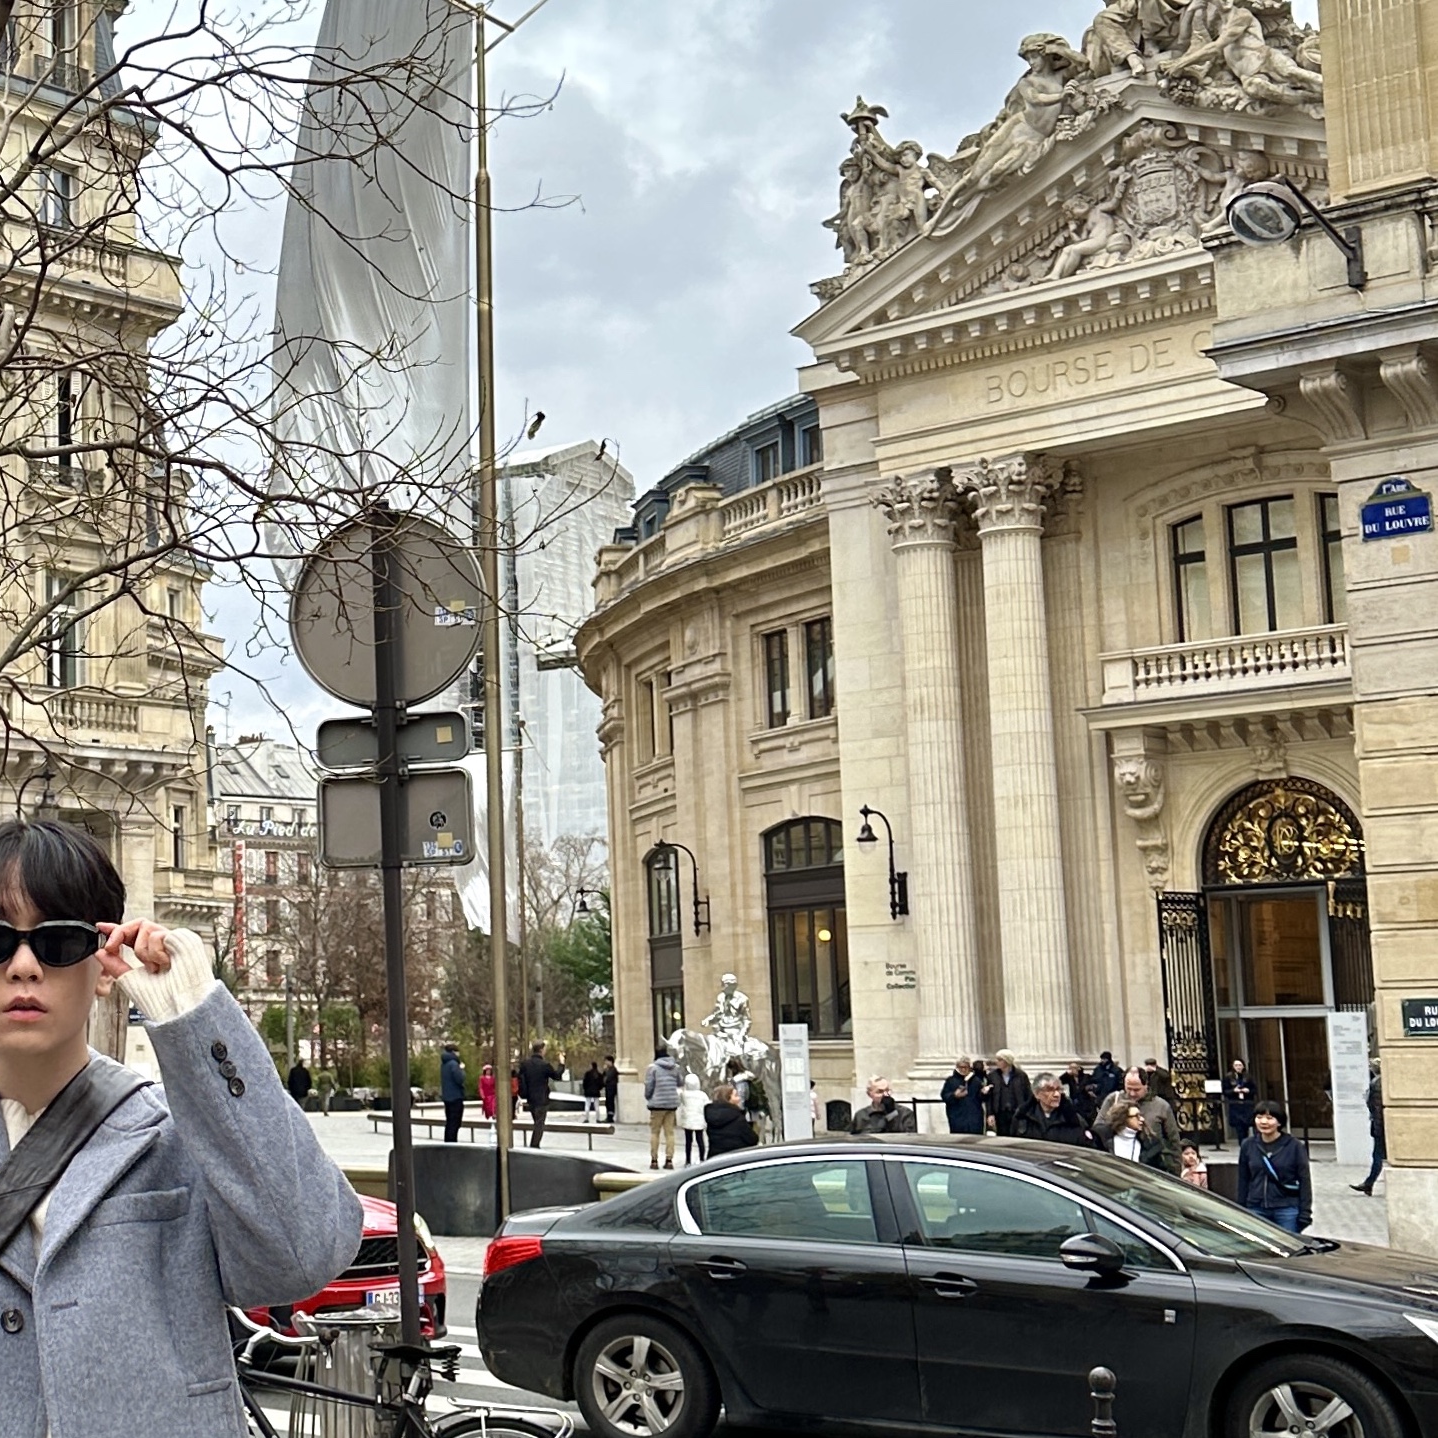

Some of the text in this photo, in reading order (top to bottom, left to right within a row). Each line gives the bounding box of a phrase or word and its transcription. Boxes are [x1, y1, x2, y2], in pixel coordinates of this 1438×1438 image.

[986, 350, 1114, 404] BOURSE
[1129, 337, 1175, 375] DE
[1384, 505, 1406, 517] RUE
[1364, 515, 1431, 534] DU LOUVRE
[259, 820, 297, 837] Pied
[1424, 1005, 1438, 1016] RU
[1409, 1017, 1438, 1028] DU LO
